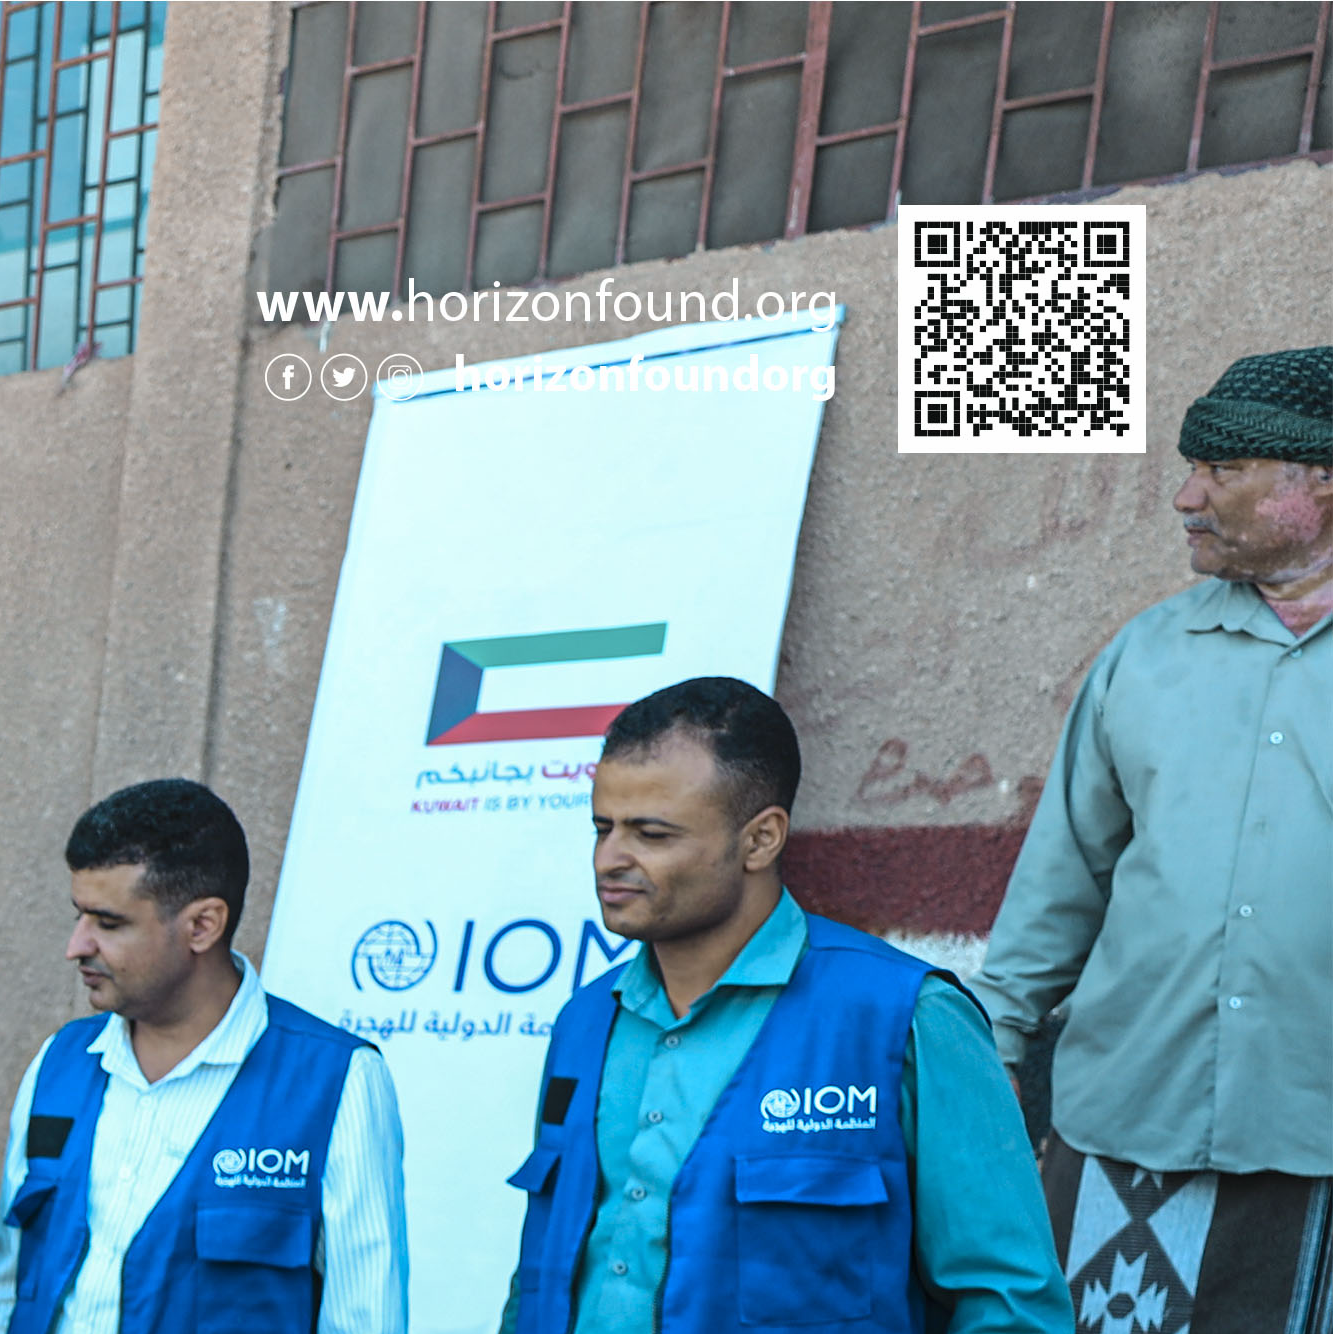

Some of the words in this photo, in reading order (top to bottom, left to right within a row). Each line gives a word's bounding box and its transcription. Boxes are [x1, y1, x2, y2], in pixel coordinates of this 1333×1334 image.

[411, 797, 479, 814] KUWAIT
[485, 795, 501, 811] IS
[506, 795, 531, 811] BY
[804, 1085, 877, 1115] IOM
[248, 1147, 310, 1176] IOM
